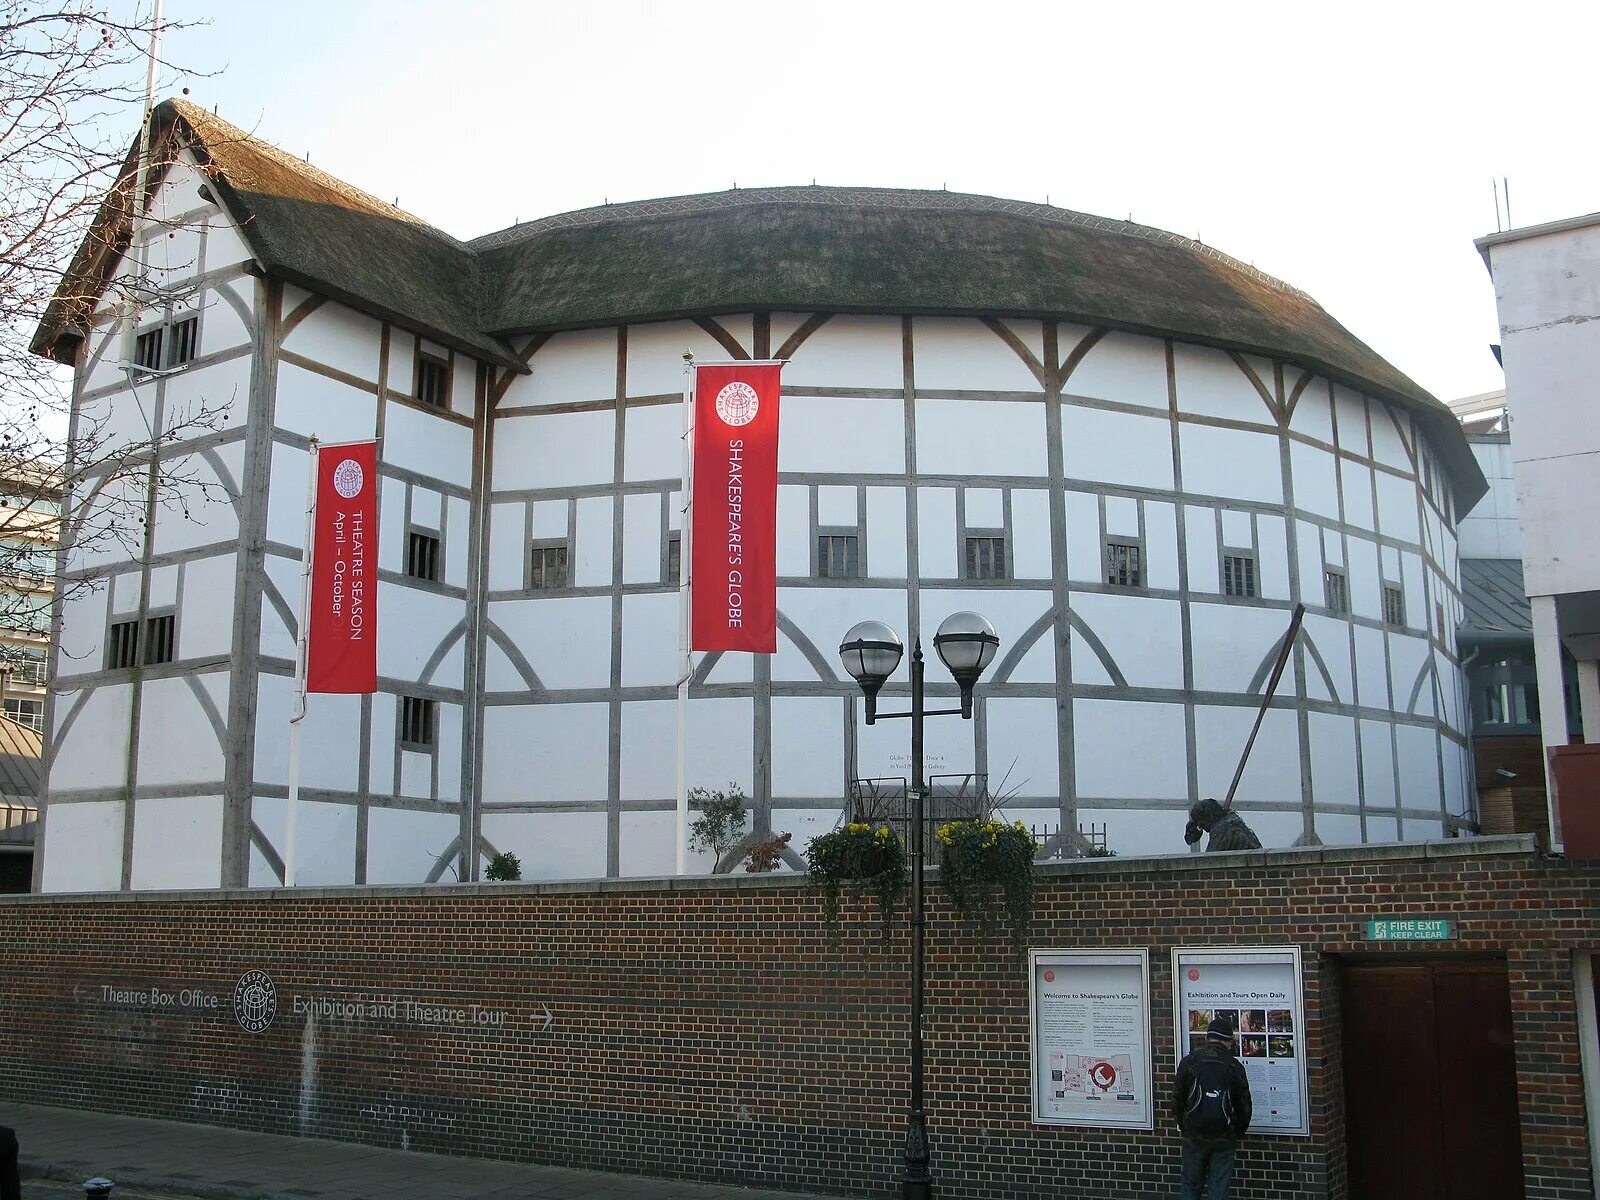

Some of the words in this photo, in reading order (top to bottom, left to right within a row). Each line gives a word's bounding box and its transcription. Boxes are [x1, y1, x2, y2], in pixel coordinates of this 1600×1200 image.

[728, 439, 743, 565] SHAKESPEARE'S
[332, 511, 346, 543] April
[352, 510, 363, 577] THEATRE
[332, 560, 346, 617] October
[728, 570, 742, 628] GLOBE
[350, 581, 363, 640] SEASON
[1390, 921, 1415, 930] FIRE
[1417, 921, 1442, 930] EXIT
[1391, 931, 1413, 939] KEEP
[1414, 931, 1442, 939] CLEAR
[101, 984, 147, 1005] Theatre
[151, 987, 176, 1006] Box
[179, 989, 219, 1009] Office
[293, 995, 364, 1018] Exhibition
[370, 999, 398, 1020] and
[402, 1001, 466, 1023] Theatre
[469, 1004, 509, 1025] Tour
[240, 1015, 268, 1030] GLOBE
